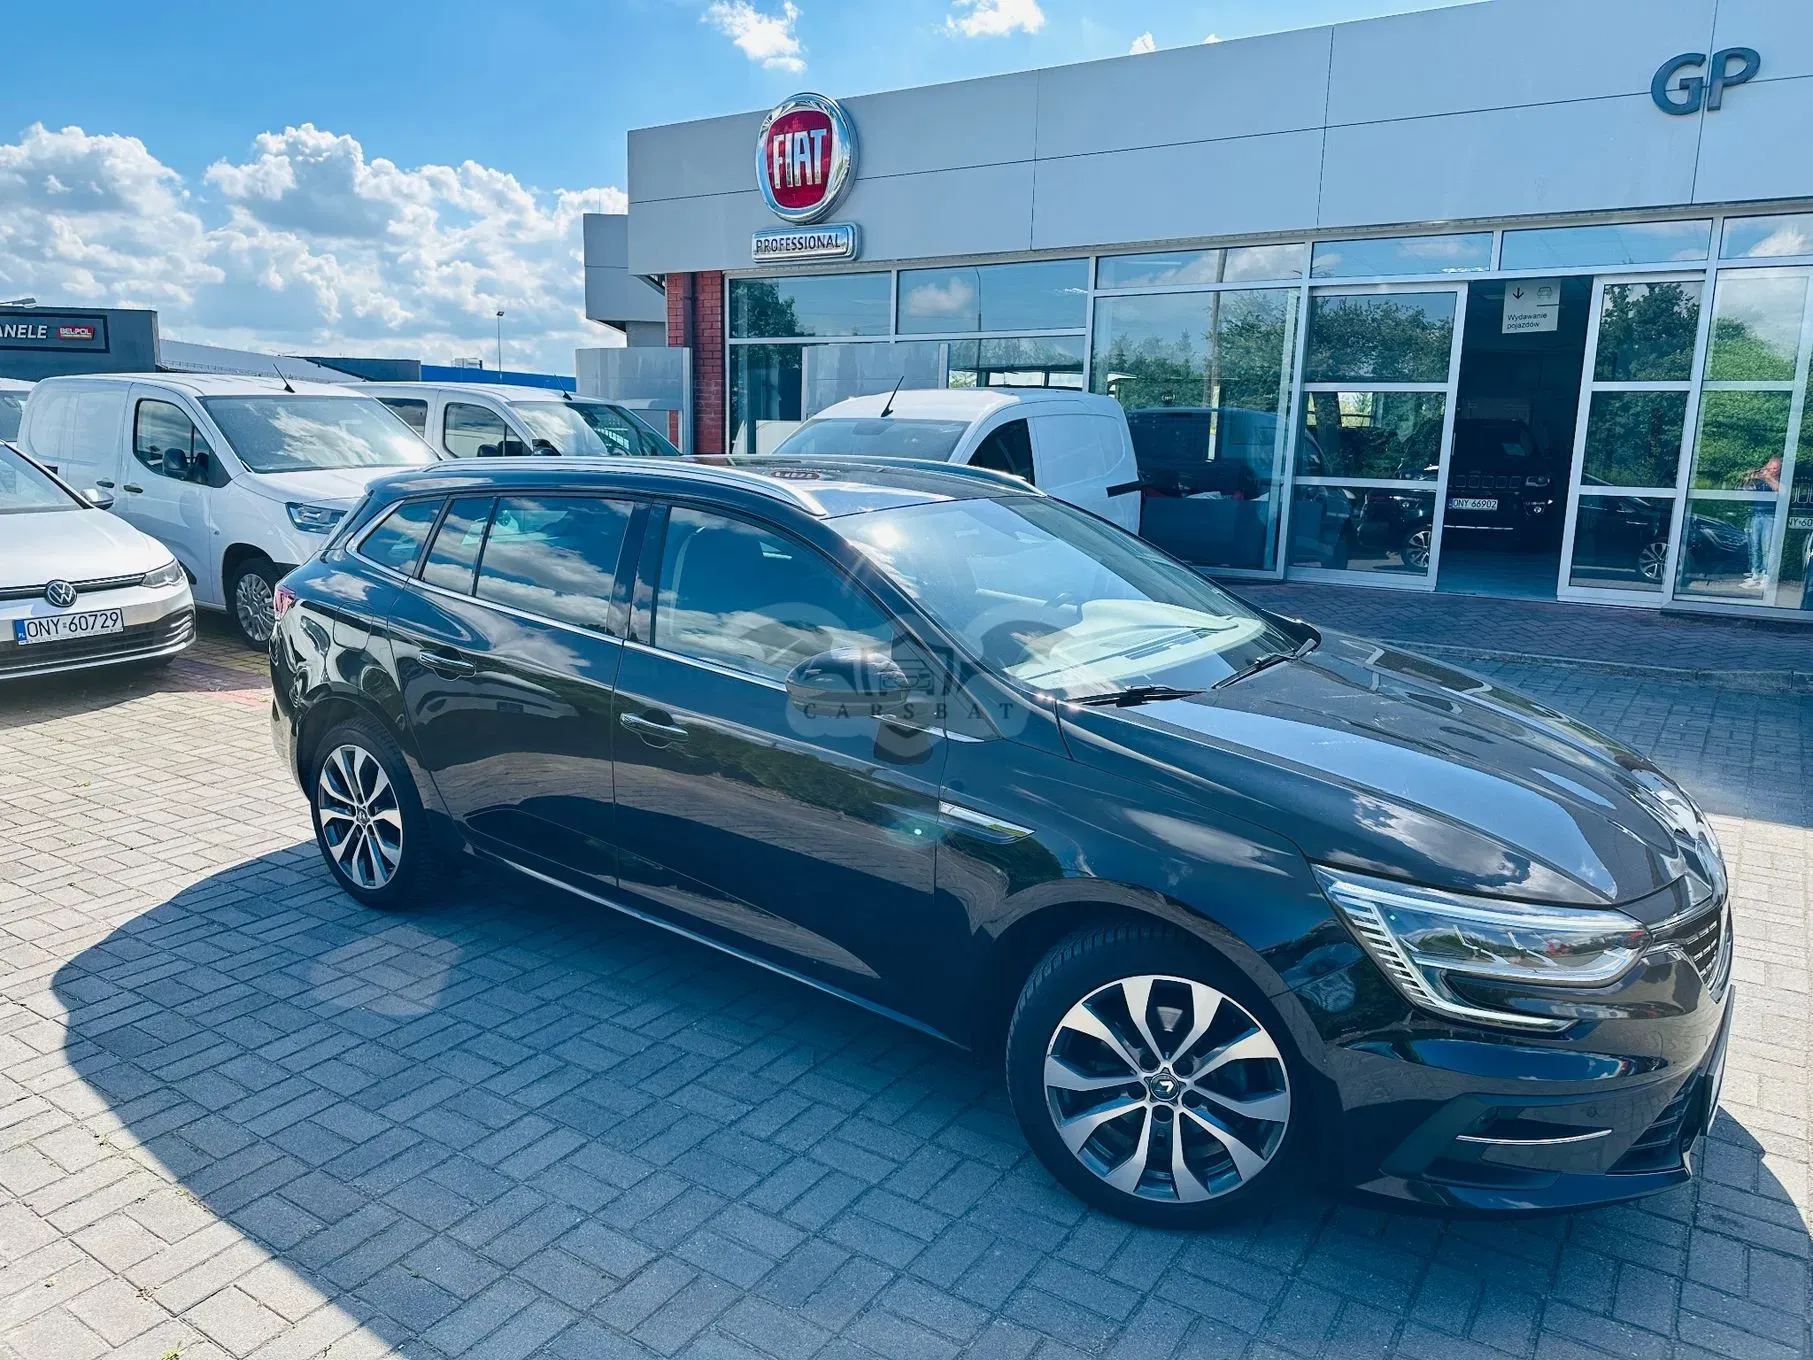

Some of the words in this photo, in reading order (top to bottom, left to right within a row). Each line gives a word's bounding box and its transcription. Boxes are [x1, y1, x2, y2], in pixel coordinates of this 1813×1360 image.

[1650, 47, 1761, 115] GP
[773, 128, 827, 189] FIAT
[756, 233, 841, 253] PROFESSIONAL
[1507, 312, 1547, 322] Wydawanie
[1507, 322, 1540, 330] pojazdów
[26, 618, 60, 638] ONY
[68, 611, 120, 632] 60729
